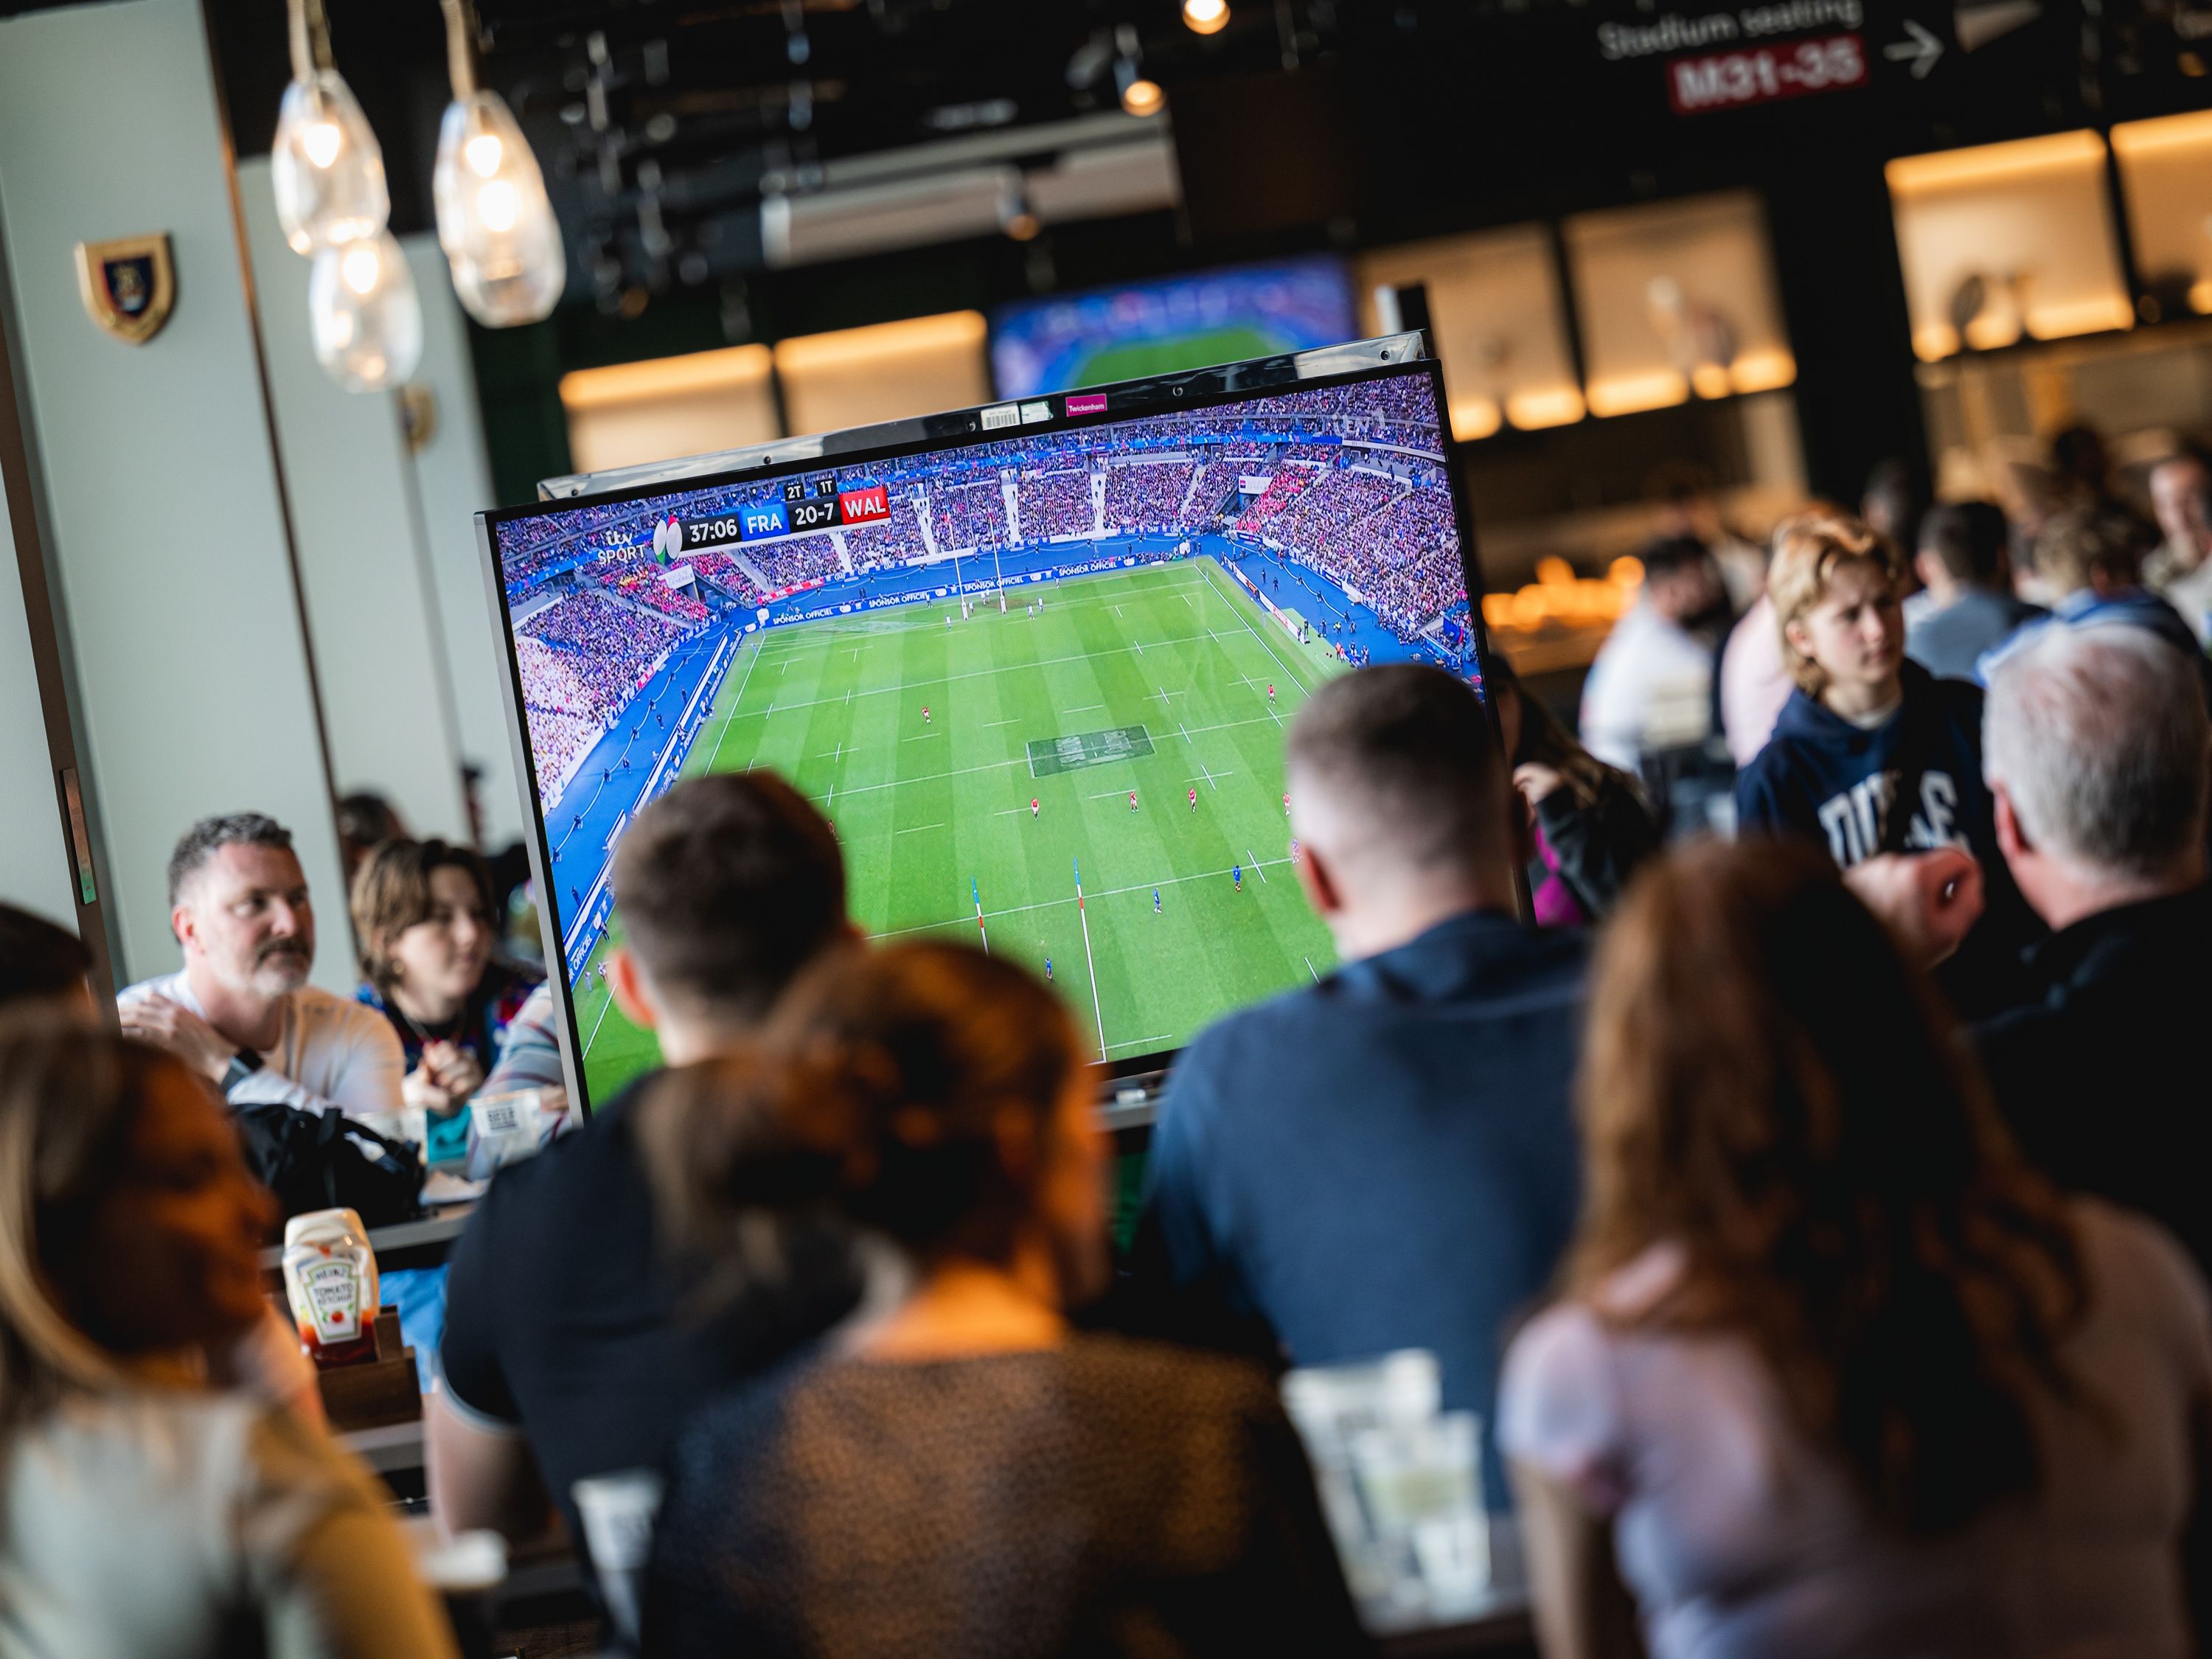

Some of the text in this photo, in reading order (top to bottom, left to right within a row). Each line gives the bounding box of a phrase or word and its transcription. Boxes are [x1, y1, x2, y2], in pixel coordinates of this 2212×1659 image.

[1598, 0, 1863, 60] Stadium seating
[1674, 35, 1864, 108] M31-35
[1068, 403, 1105, 412] Twickenham
[787, 480, 832, 499] 2T 1T
[689, 495, 886, 542] 37:06 FRA 20-7 WAL
[605, 530, 633, 546] itv
[597, 544, 645, 566] SPORT
[1059, 564, 1089, 577] SPONSOR
[964, 581, 995, 592] SPONSOR
[869, 597, 900, 608] SPONSOR
[773, 608, 833, 625] SPONSOR OFFICIEL
[316, 1267, 346, 1279] HEINZ
[313, 1283, 354, 1298] TOMATO
